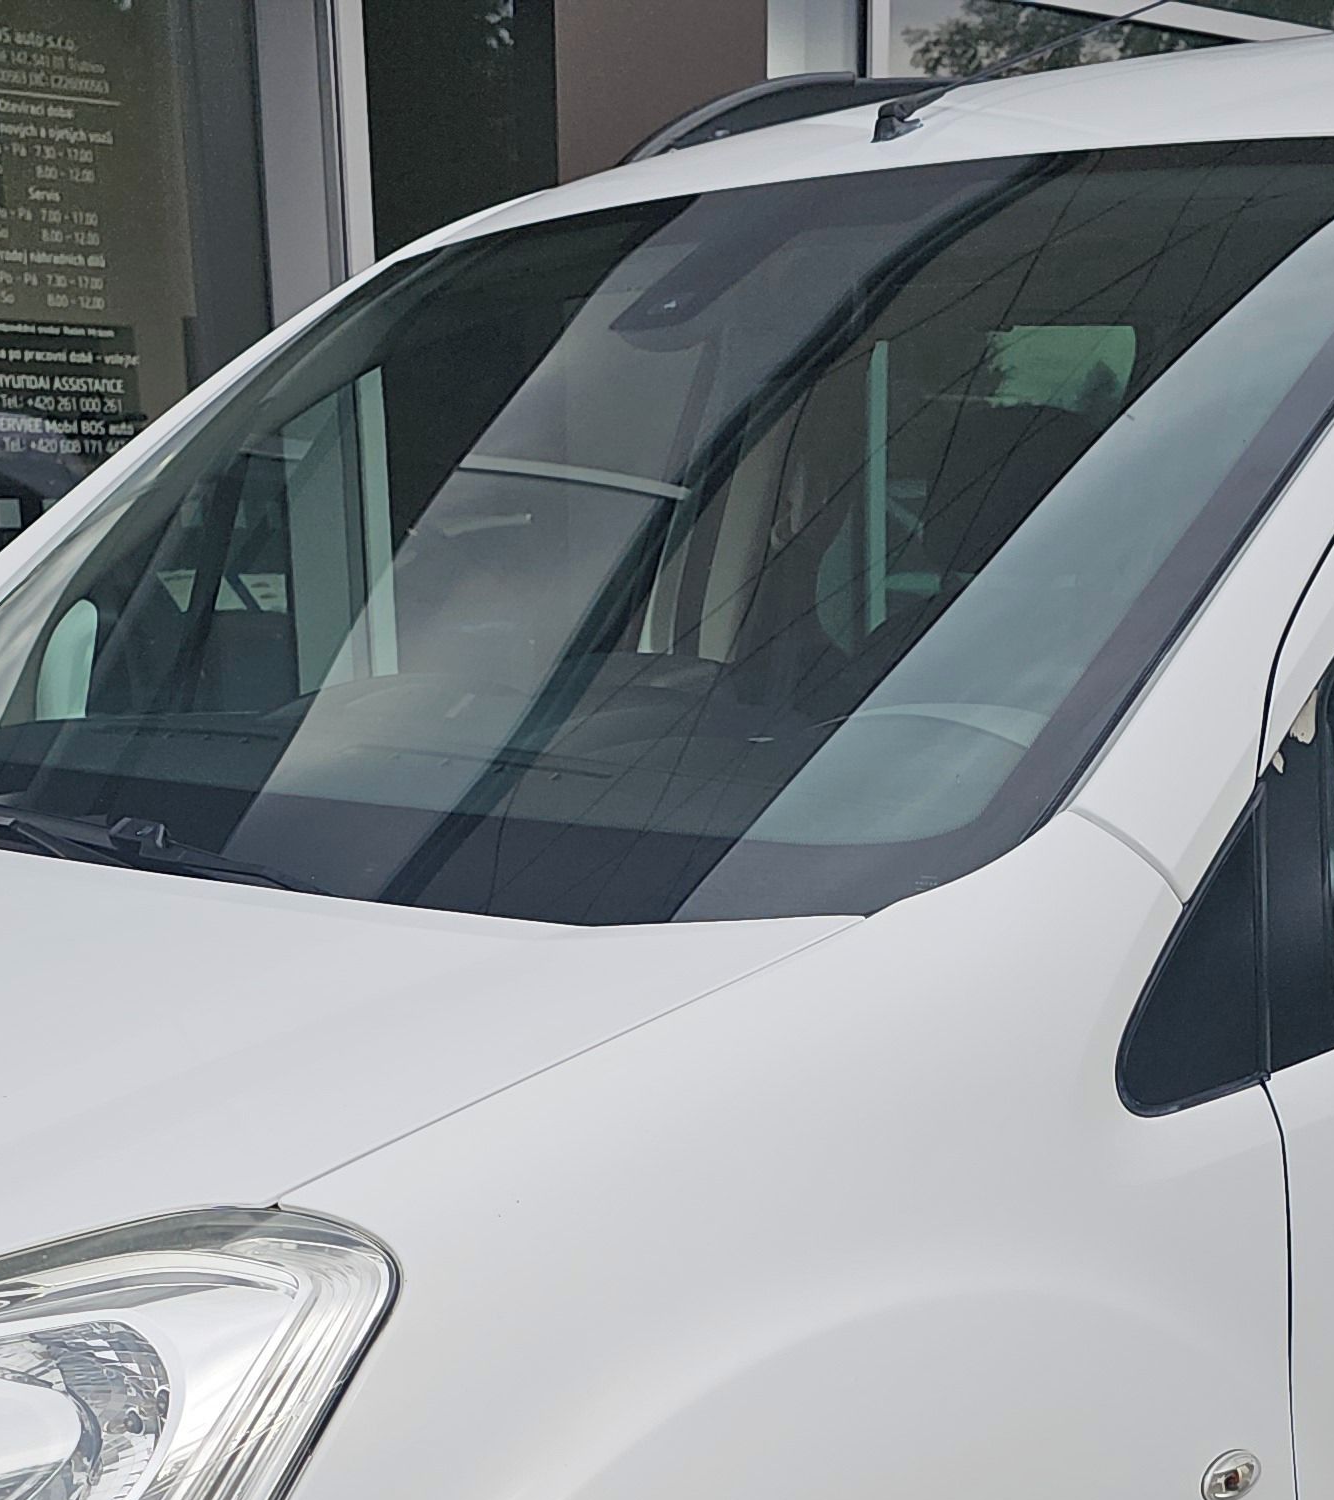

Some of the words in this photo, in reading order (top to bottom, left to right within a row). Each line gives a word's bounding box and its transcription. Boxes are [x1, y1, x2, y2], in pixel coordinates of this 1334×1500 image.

[52, 375, 126, 394] ASSISTANCE
[27, 395, 55, 411] +420
[79, 396, 101, 413] 000
